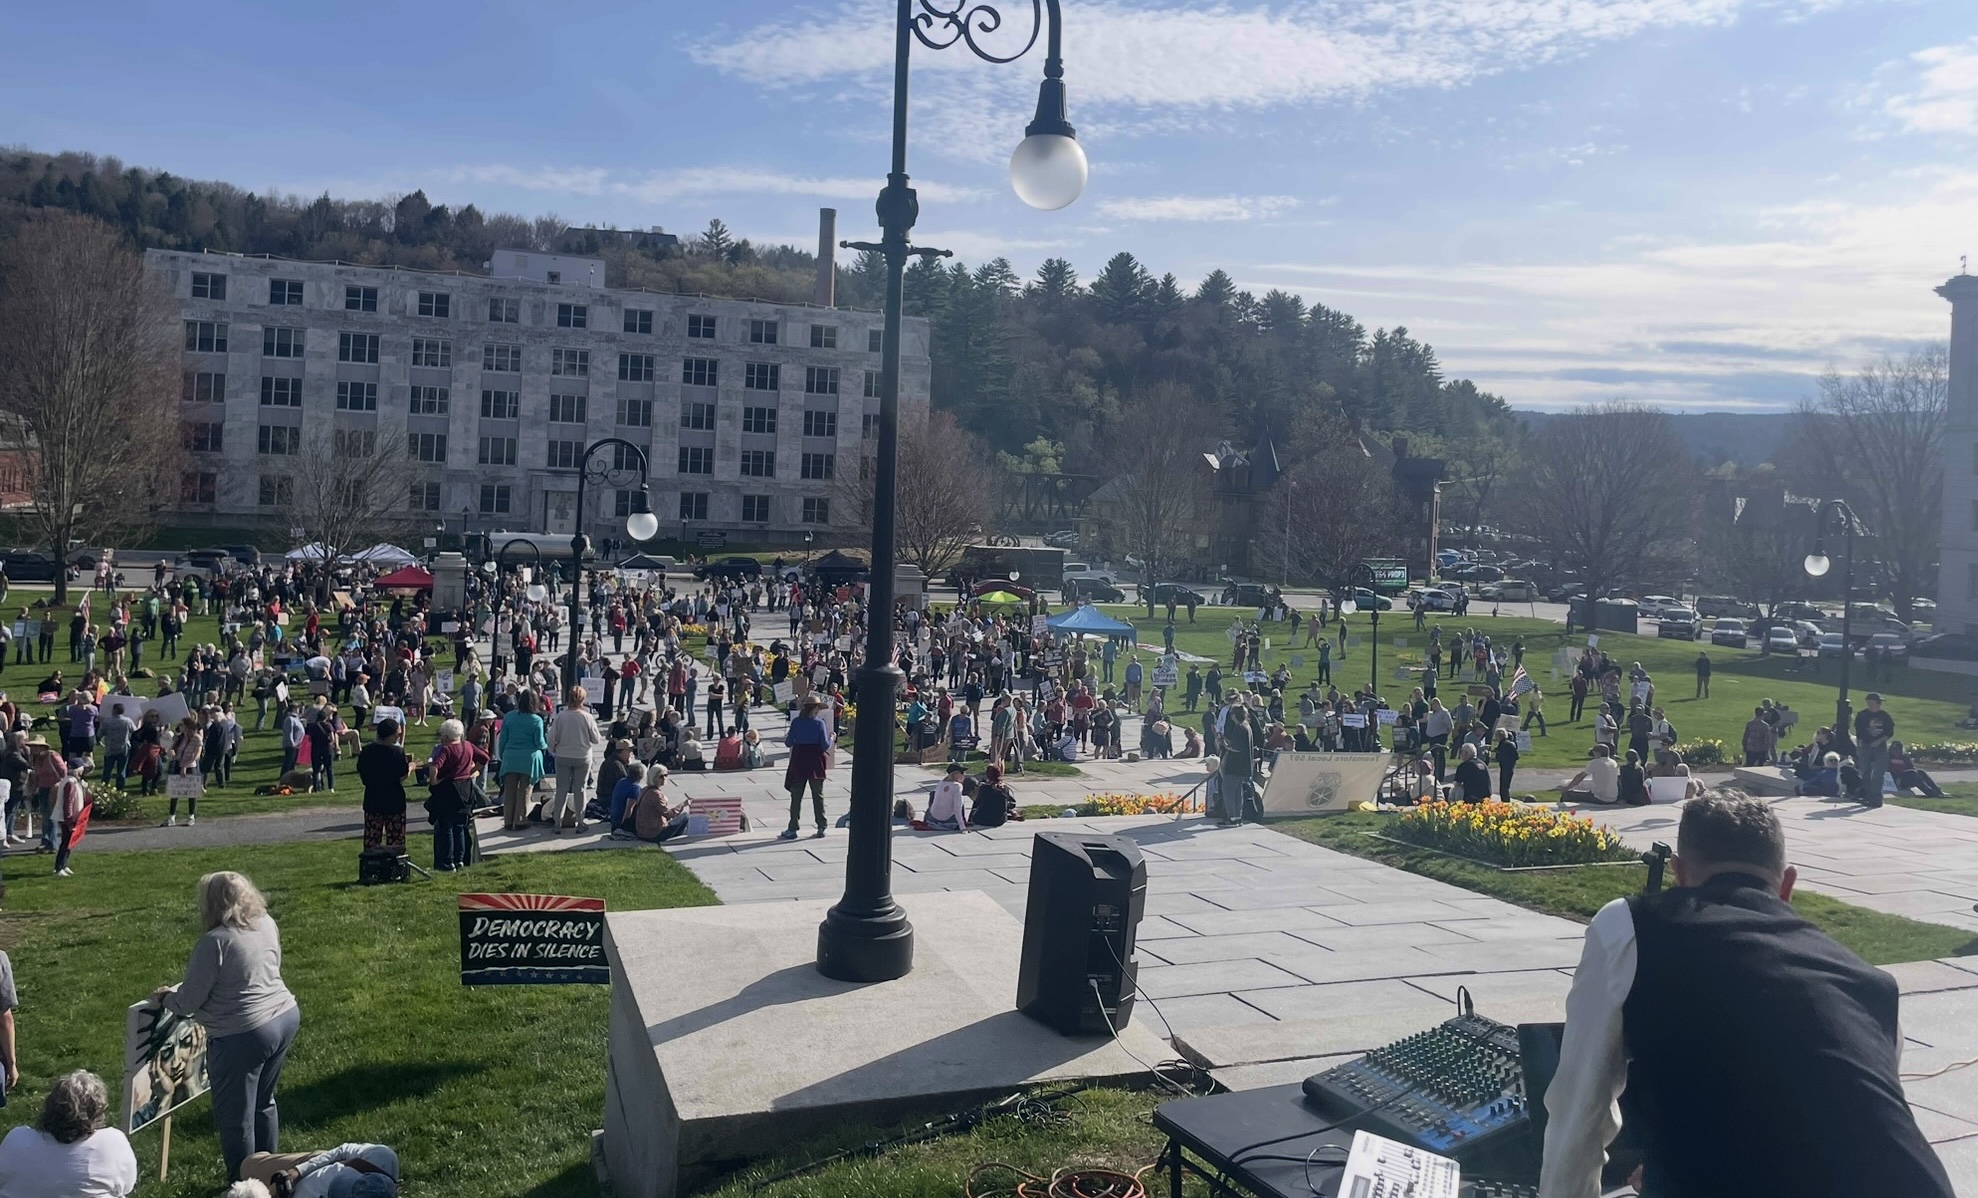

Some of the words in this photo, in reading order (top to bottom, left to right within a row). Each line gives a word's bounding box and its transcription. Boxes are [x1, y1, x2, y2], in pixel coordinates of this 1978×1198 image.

[468, 916, 601, 940] DEMOCRACY
[468, 942, 509, 959] DIES
[510, 942, 532, 958] IN
[533, 943, 602, 959] SILENCE
